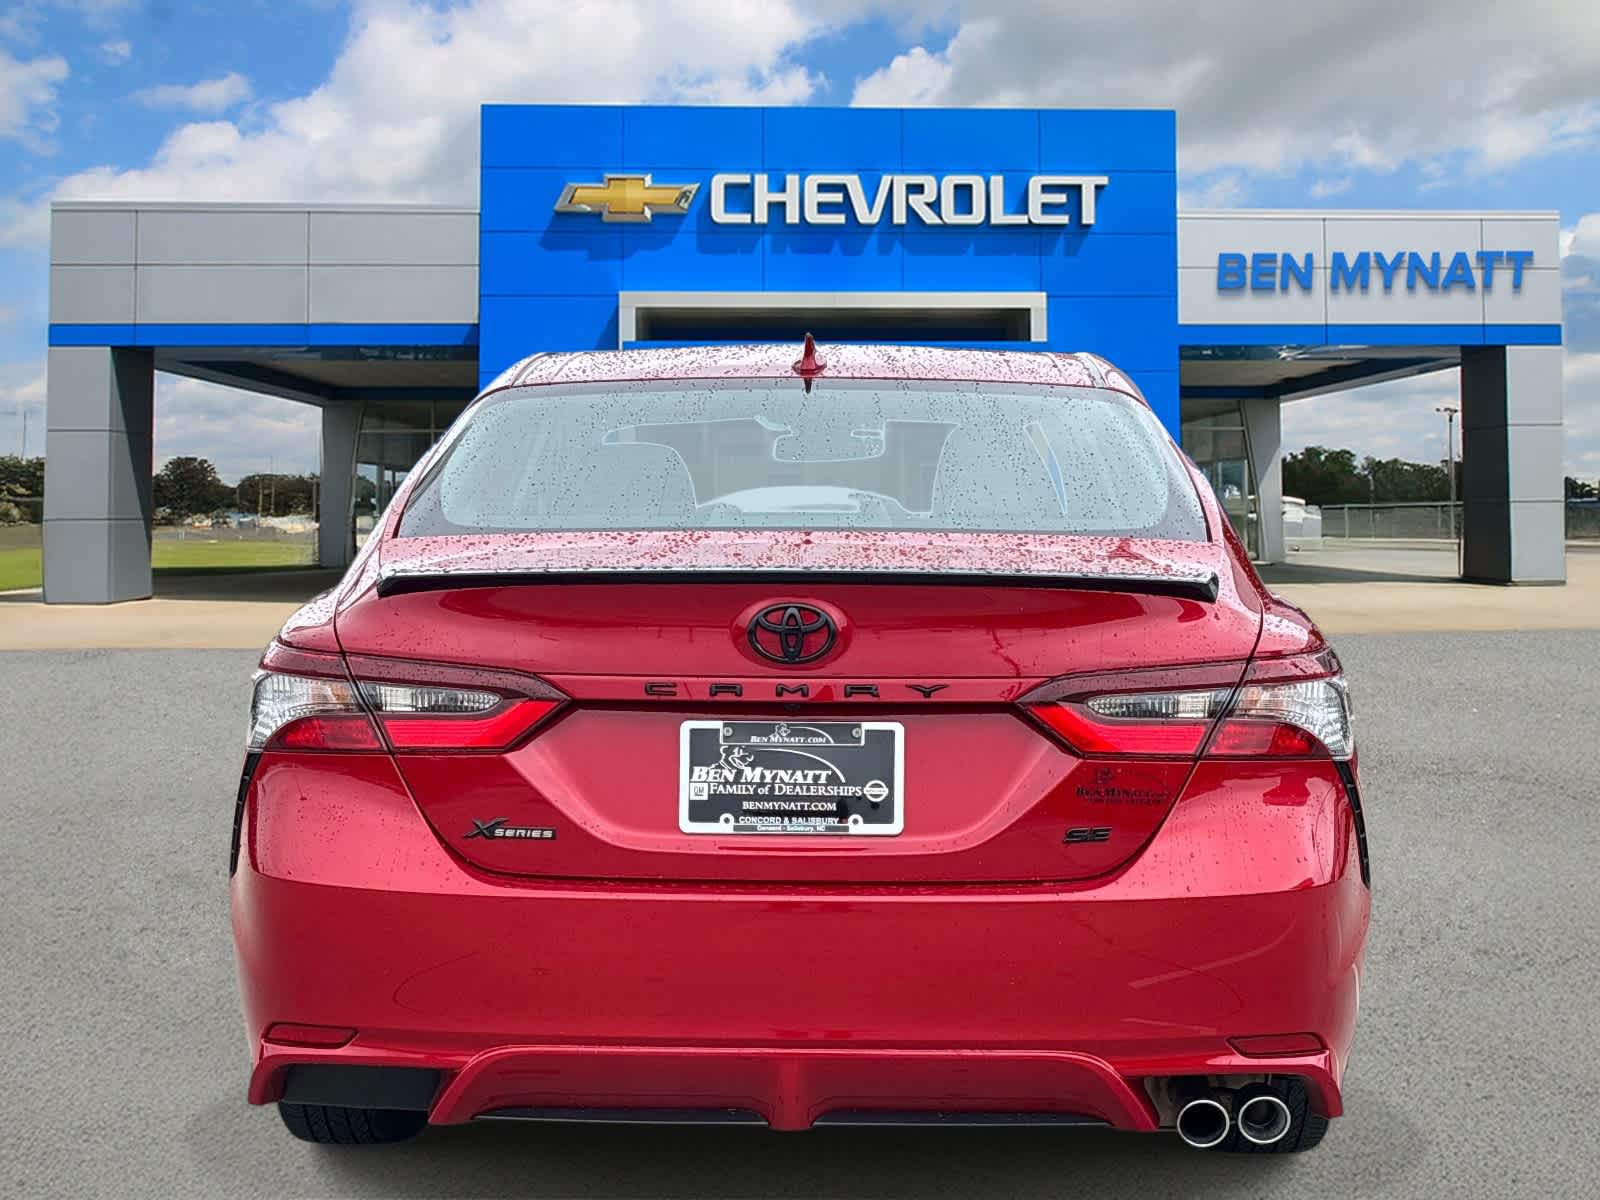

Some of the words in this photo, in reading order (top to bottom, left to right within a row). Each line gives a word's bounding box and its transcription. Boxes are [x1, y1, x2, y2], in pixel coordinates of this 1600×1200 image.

[709, 173, 1110, 226] CHEVROLET
[1217, 251, 1314, 292] BEN
[1329, 250, 1535, 292] MYNATT
[644, 681, 950, 697] CAMRY
[750, 735, 768, 743] BEN
[690, 766, 737, 782] BEN
[740, 766, 832, 783] MYNATT
[709, 782, 756, 795] FAMILY
[757, 785, 771, 795] of
[774, 783, 863, 797] DEALERSHIPS
[742, 801, 837, 811] BENMYNATT.COM
[739, 816, 781, 824] CONCORD
[783, 816, 790, 824] &
[791, 816, 840, 825] SALISBURY
[1062, 826, 1112, 844] SE
